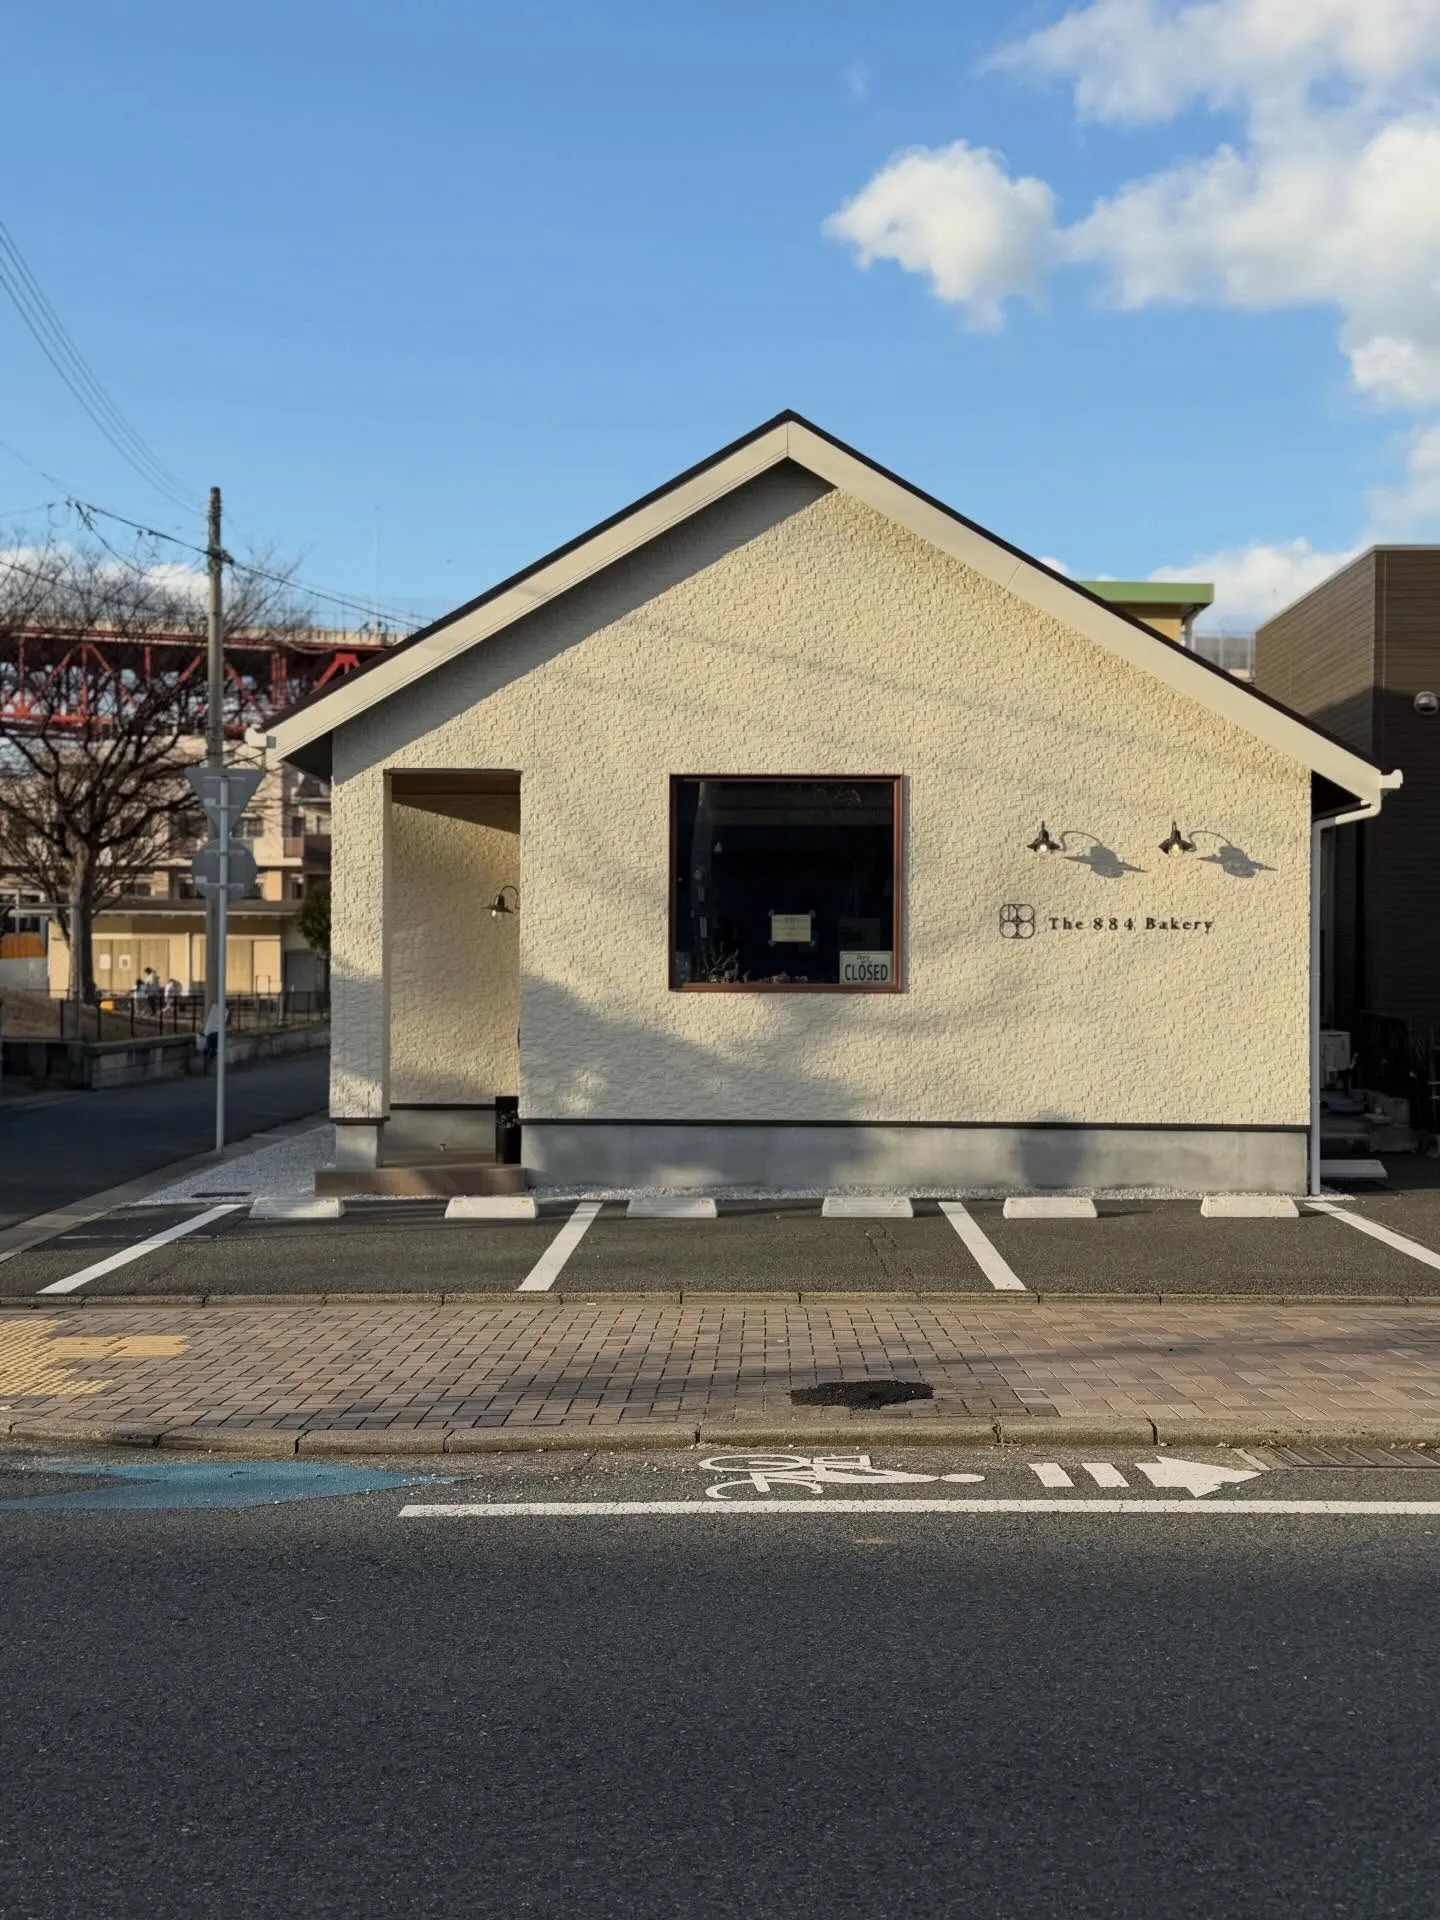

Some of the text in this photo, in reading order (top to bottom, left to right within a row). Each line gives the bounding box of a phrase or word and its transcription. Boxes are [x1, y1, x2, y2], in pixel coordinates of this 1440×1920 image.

[1048, 917, 1213, 934] The 884 Bakery
[845, 964, 888, 981] CLOSED
